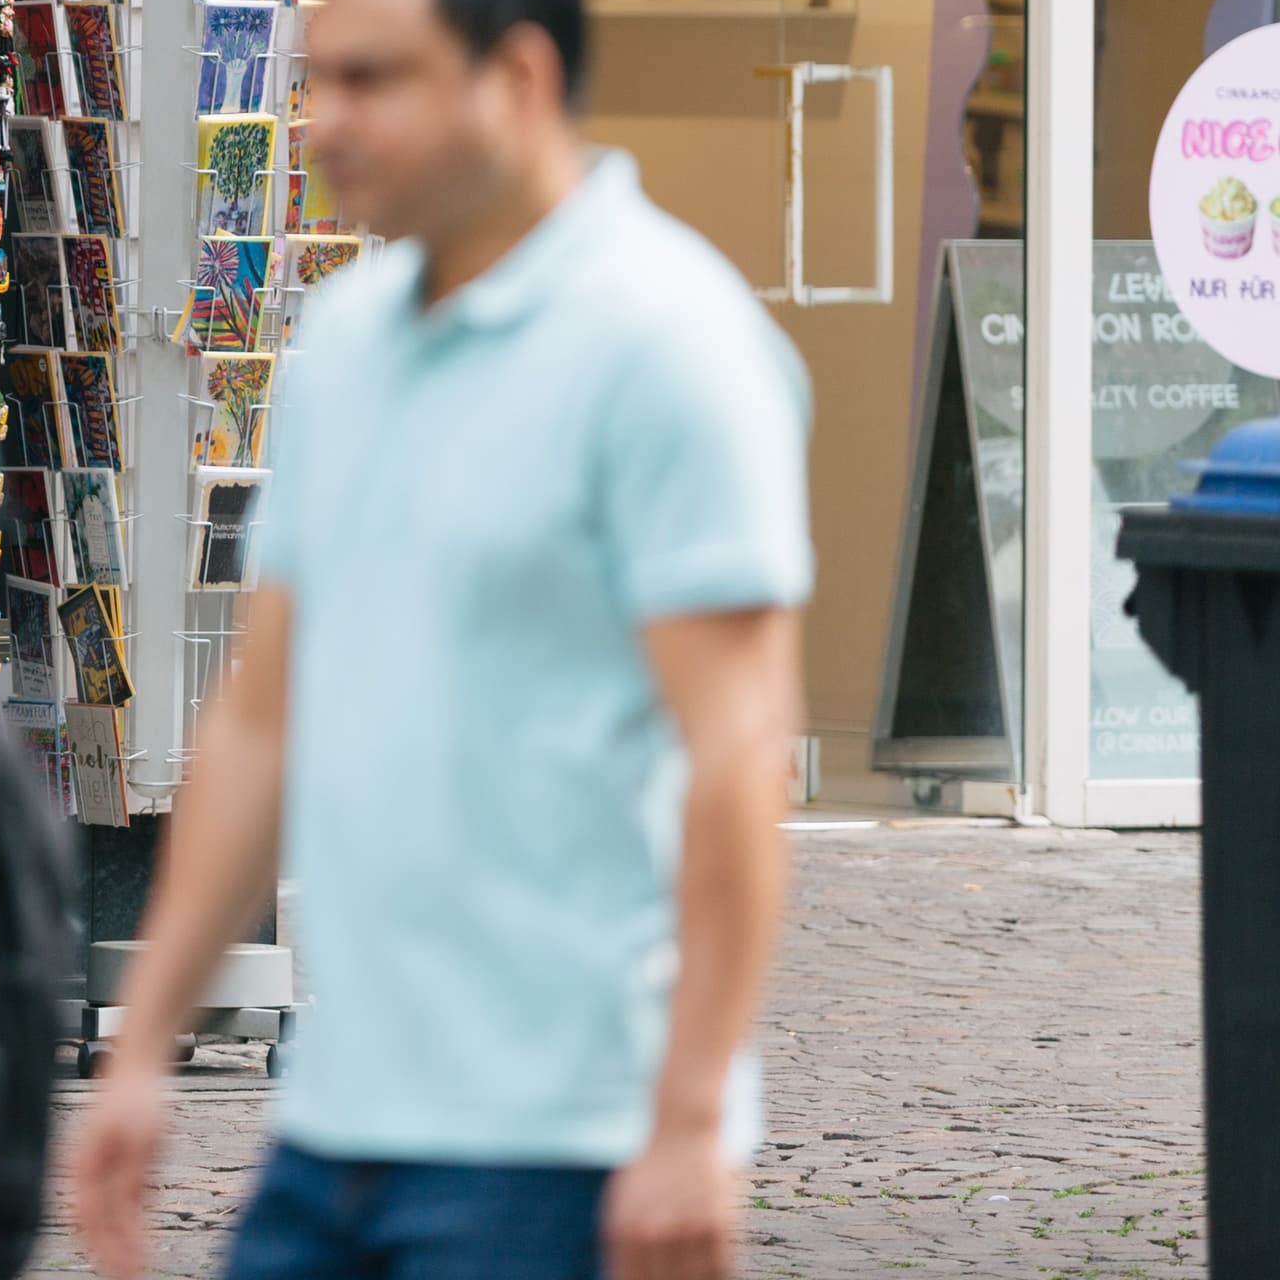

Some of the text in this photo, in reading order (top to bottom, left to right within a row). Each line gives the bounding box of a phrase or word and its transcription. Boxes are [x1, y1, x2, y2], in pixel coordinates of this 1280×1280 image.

[1181, 116, 1275, 162] NICE
[1190, 279, 1226, 298] NUR
[1147, 383, 1240, 409] COFFEE
